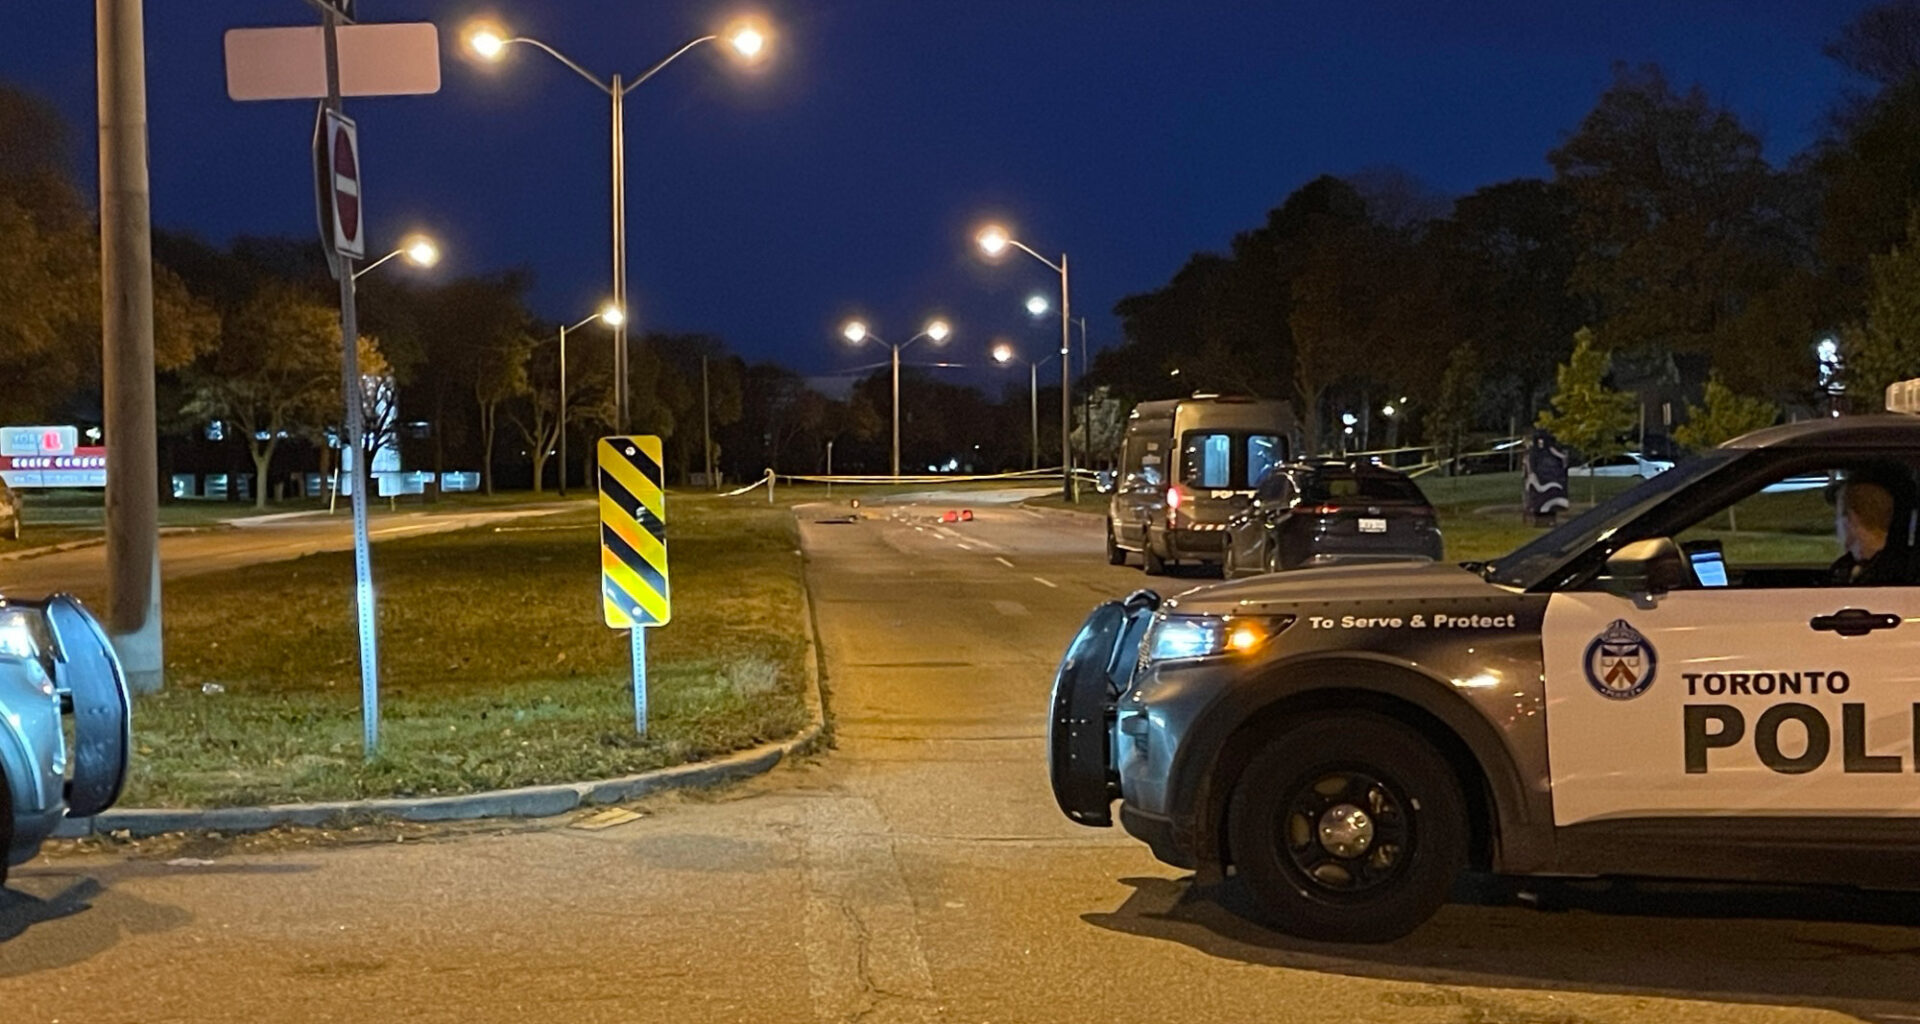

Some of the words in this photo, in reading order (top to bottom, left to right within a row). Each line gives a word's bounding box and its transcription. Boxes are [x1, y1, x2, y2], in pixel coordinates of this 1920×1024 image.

[1309, 616, 1334, 629] To
[1341, 615, 1403, 628] Serve
[1410, 614, 1426, 628] &
[1434, 614, 1515, 628] Protect
[1682, 671, 1849, 696] TORONTO
